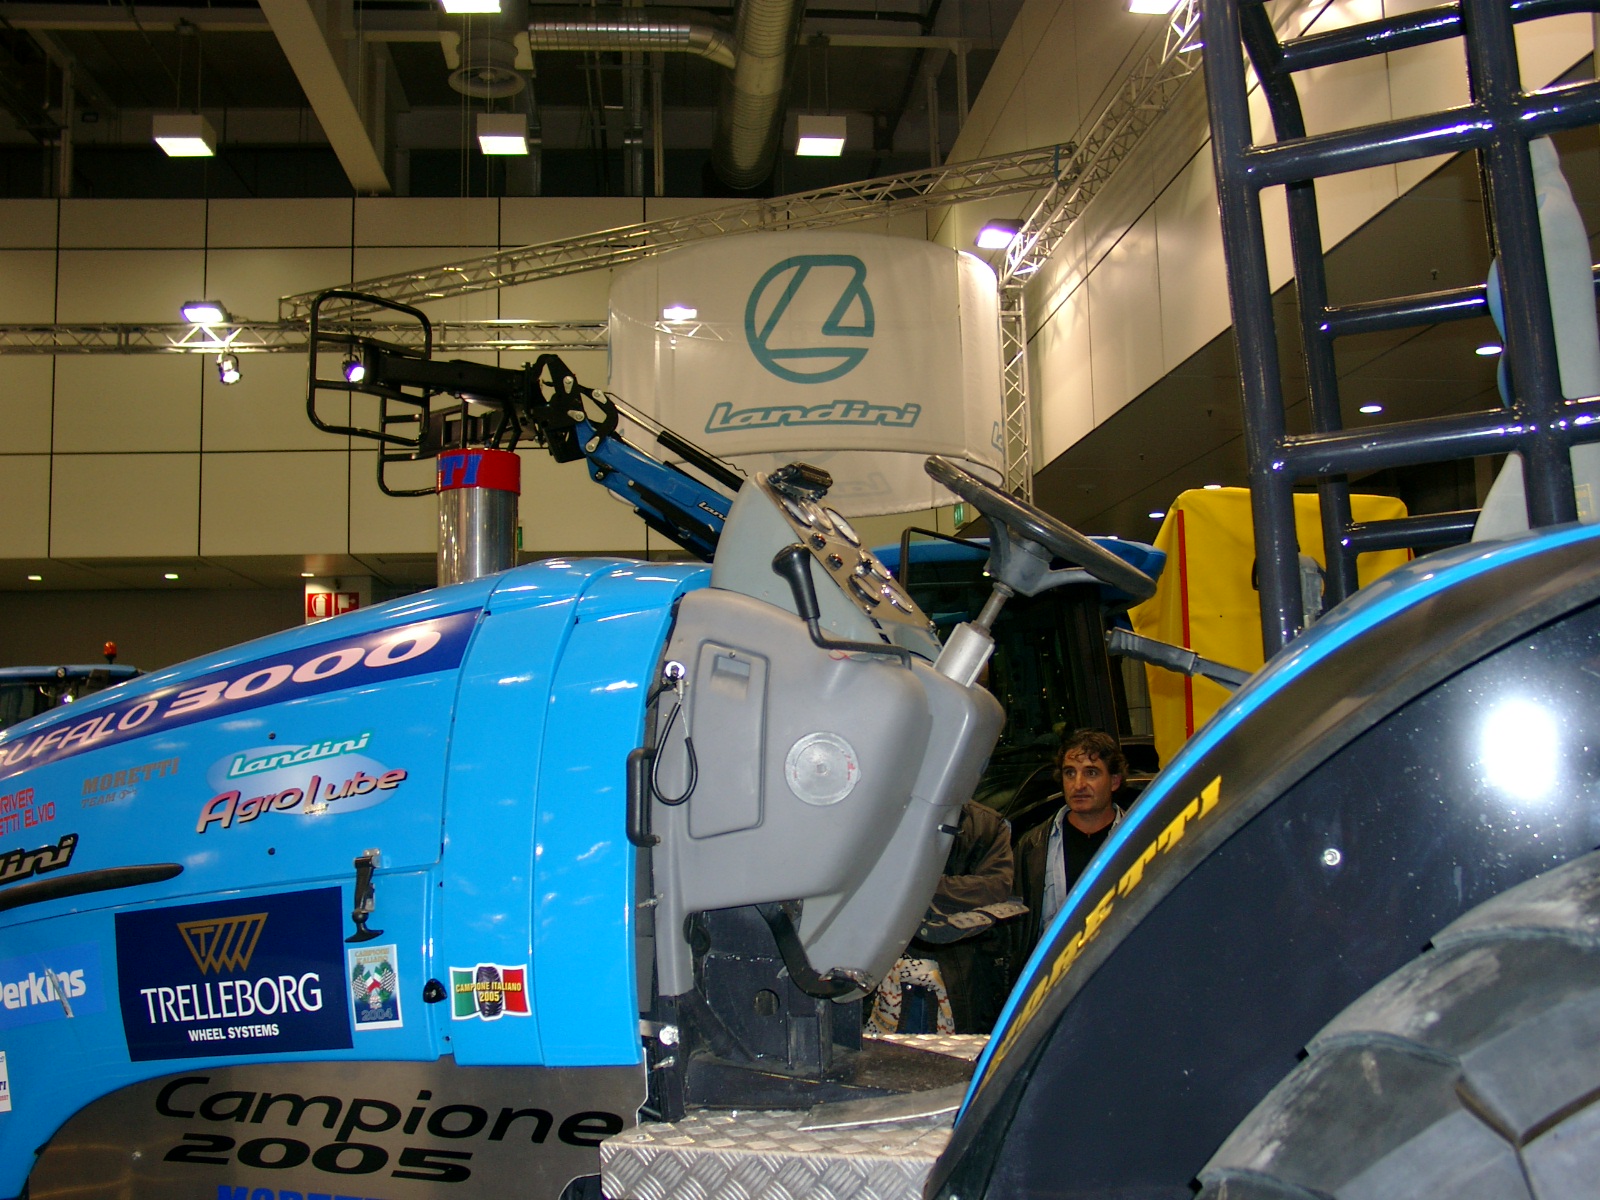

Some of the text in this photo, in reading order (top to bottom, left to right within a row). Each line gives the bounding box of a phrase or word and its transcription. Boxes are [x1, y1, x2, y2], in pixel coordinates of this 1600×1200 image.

[704, 399, 922, 434] Landini
[163, 631, 441, 718] 3000
[228, 731, 372, 778] Landini
[82, 757, 180, 796] MORETTI
[24, 801, 56, 828] ELVIO
[81, 791, 116, 809] TEAM
[196, 769, 407, 833] AgroLube
[0, 969, 86, 1010] erkins
[140, 972, 323, 1024] TRELLEBORG
[455, 982, 522, 993] CAMPIONE ITALIANO
[480, 991, 500, 1003] 2005
[188, 1023, 279, 1042] WHEEL SYSTEMS
[361, 1007, 393, 1022] 2004
[155, 1076, 624, 1147] Campione
[163, 1132, 473, 1183] 2005
